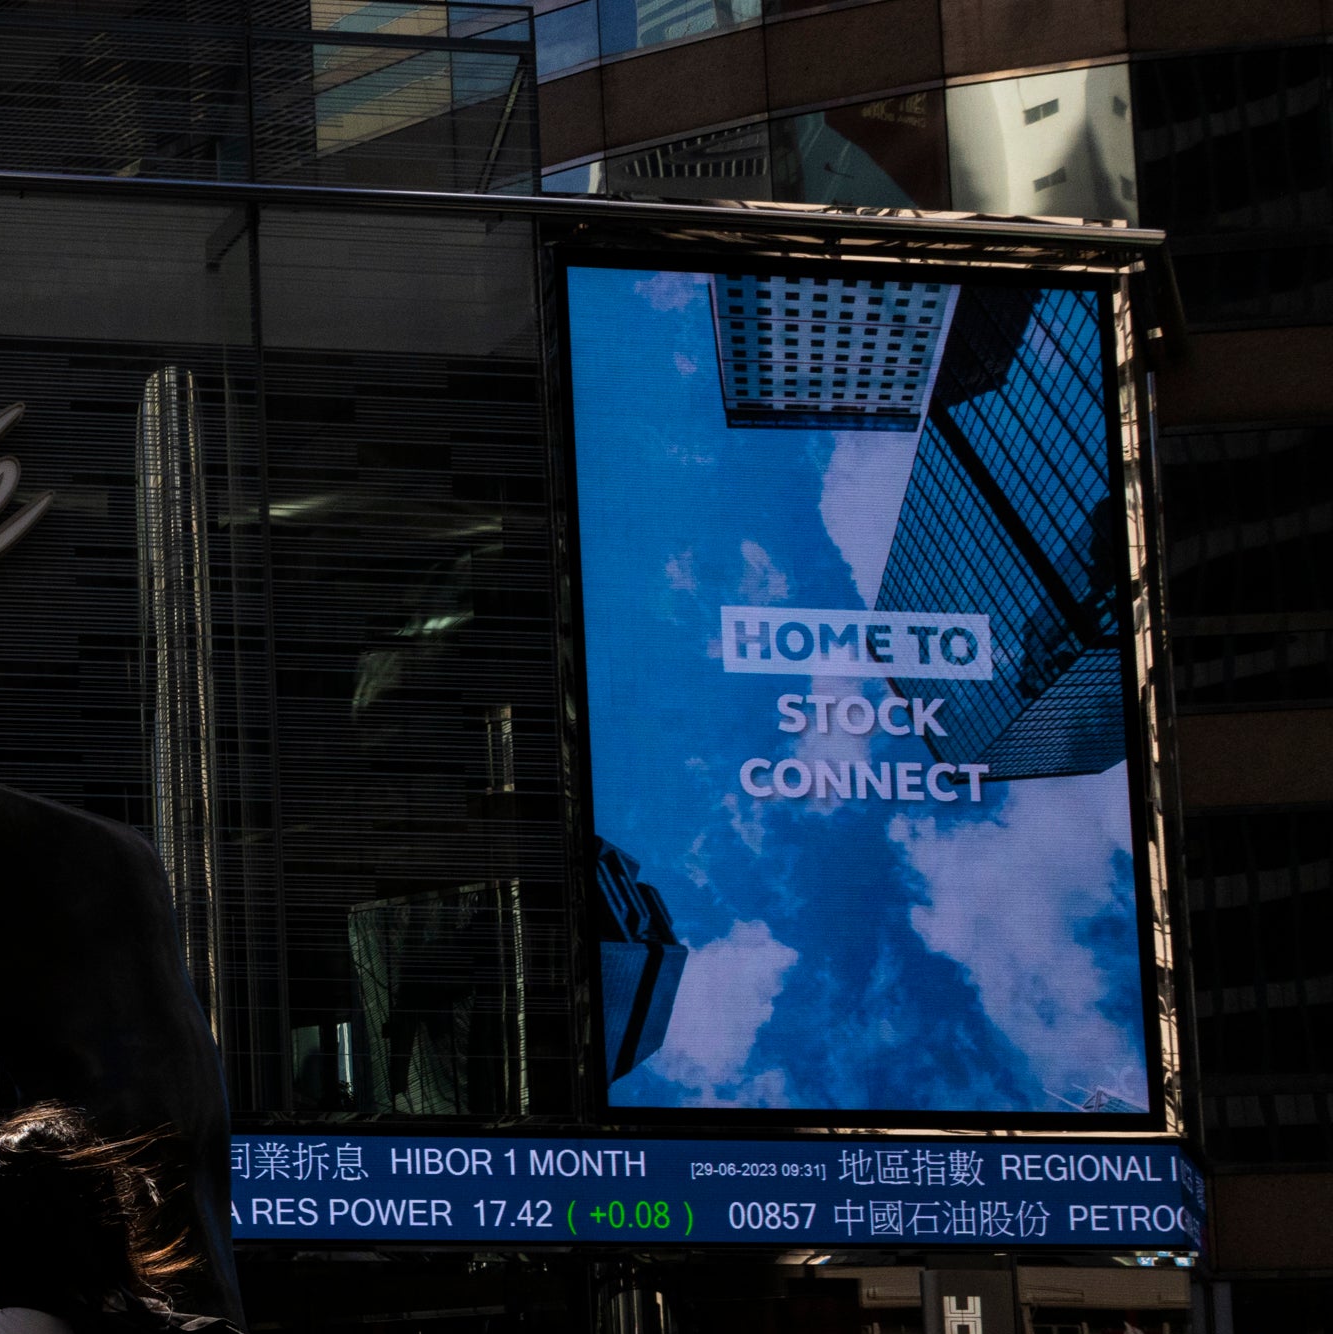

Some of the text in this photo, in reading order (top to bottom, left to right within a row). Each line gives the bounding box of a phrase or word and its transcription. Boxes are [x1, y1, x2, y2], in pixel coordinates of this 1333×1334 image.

[734, 620, 979, 666] HOME TO
[777, 693, 948, 736] STOCK
[739, 757, 990, 802] CONNECT
[391, 1147, 493, 1176] HIBOR
[504, 1148, 516, 1176] 1
[529, 1149, 646, 1177] MONTH
[838, 1148, 985, 1187] 地區指數
[1001, 1154, 1163, 1182] REGIONAL
[251, 1197, 319, 1226] RES
[329, 1197, 453, 1227] POWER
[473, 1199, 553, 1228] 17.42
[729, 1201, 817, 1230] 00857
[834, 1198, 1051, 1237] 中國石油股份
